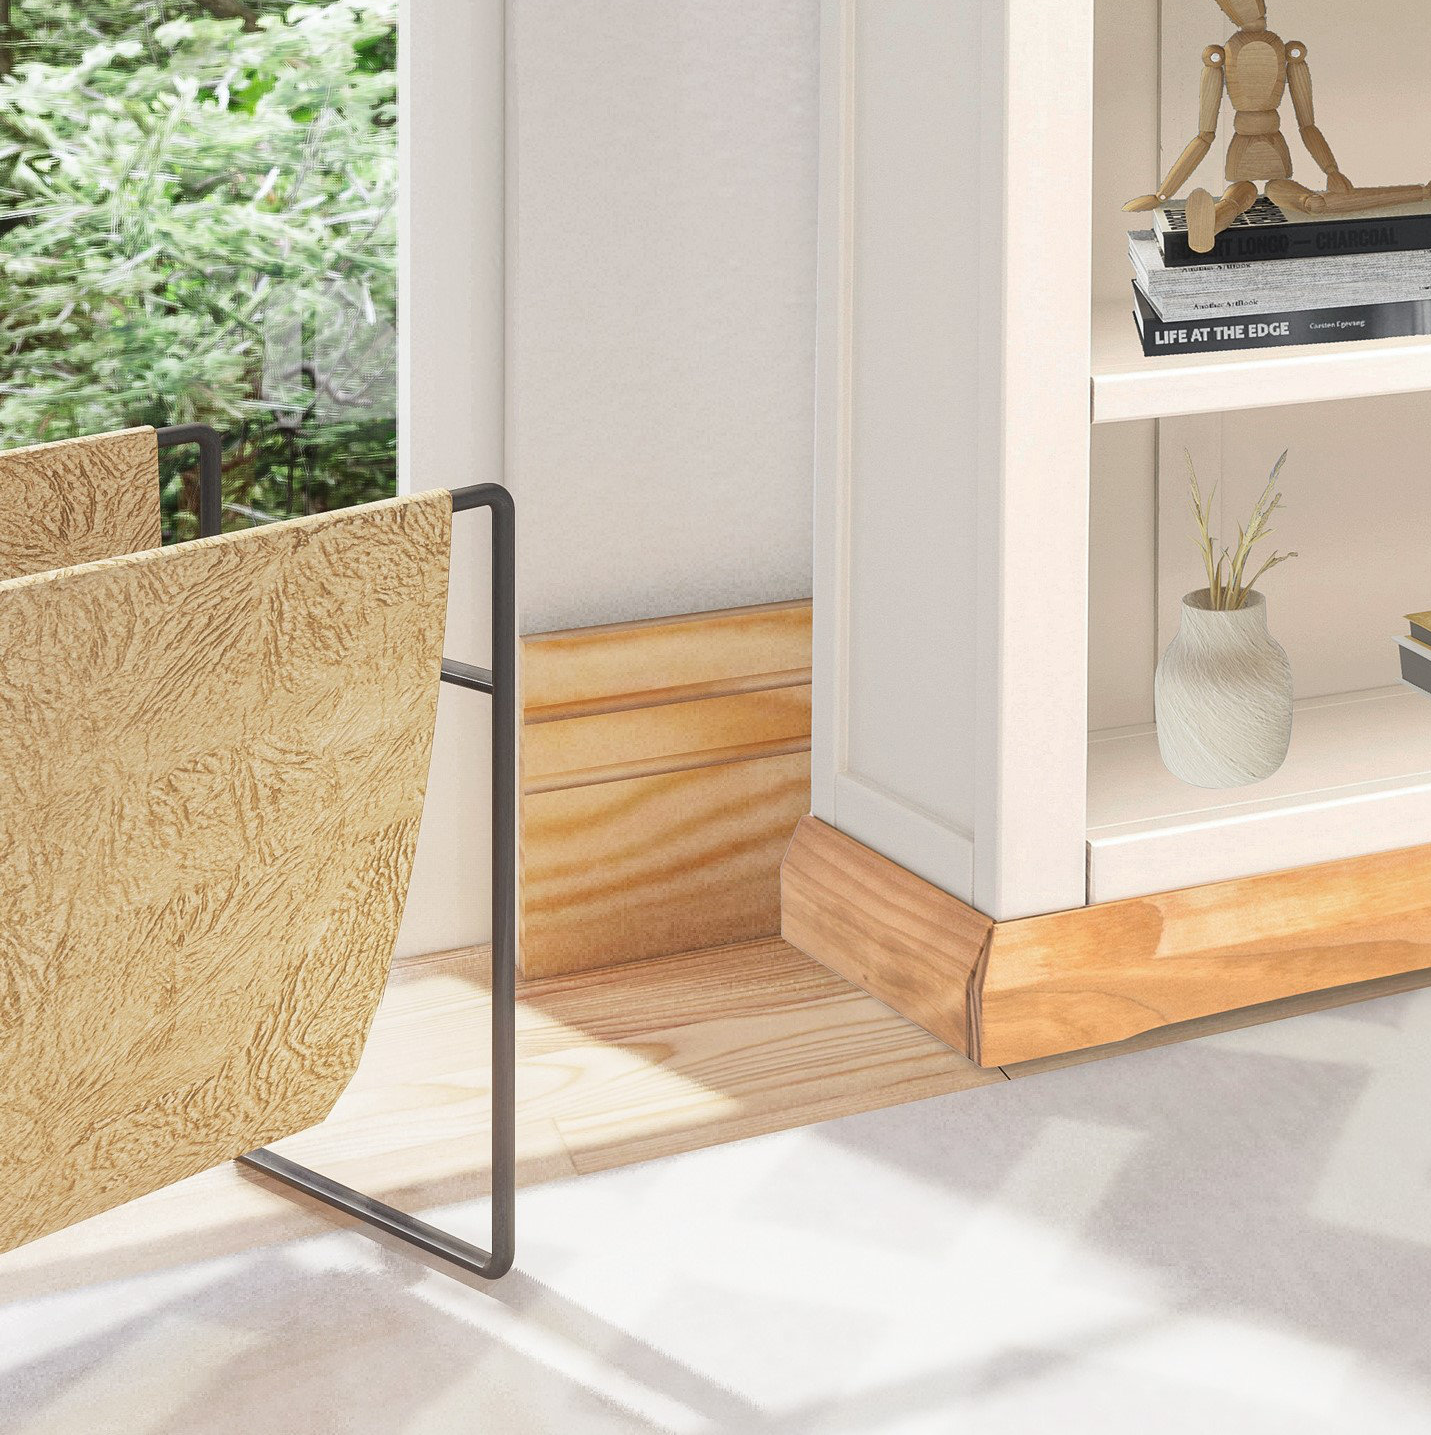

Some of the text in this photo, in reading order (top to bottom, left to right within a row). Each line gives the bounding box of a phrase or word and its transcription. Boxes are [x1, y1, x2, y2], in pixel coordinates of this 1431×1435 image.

[1240, 235, 1289, 255] LONGO
[1316, 227, 1399, 250] CHARCOAL
[1155, 322, 1290, 344] LIFE AT THE EDGE
